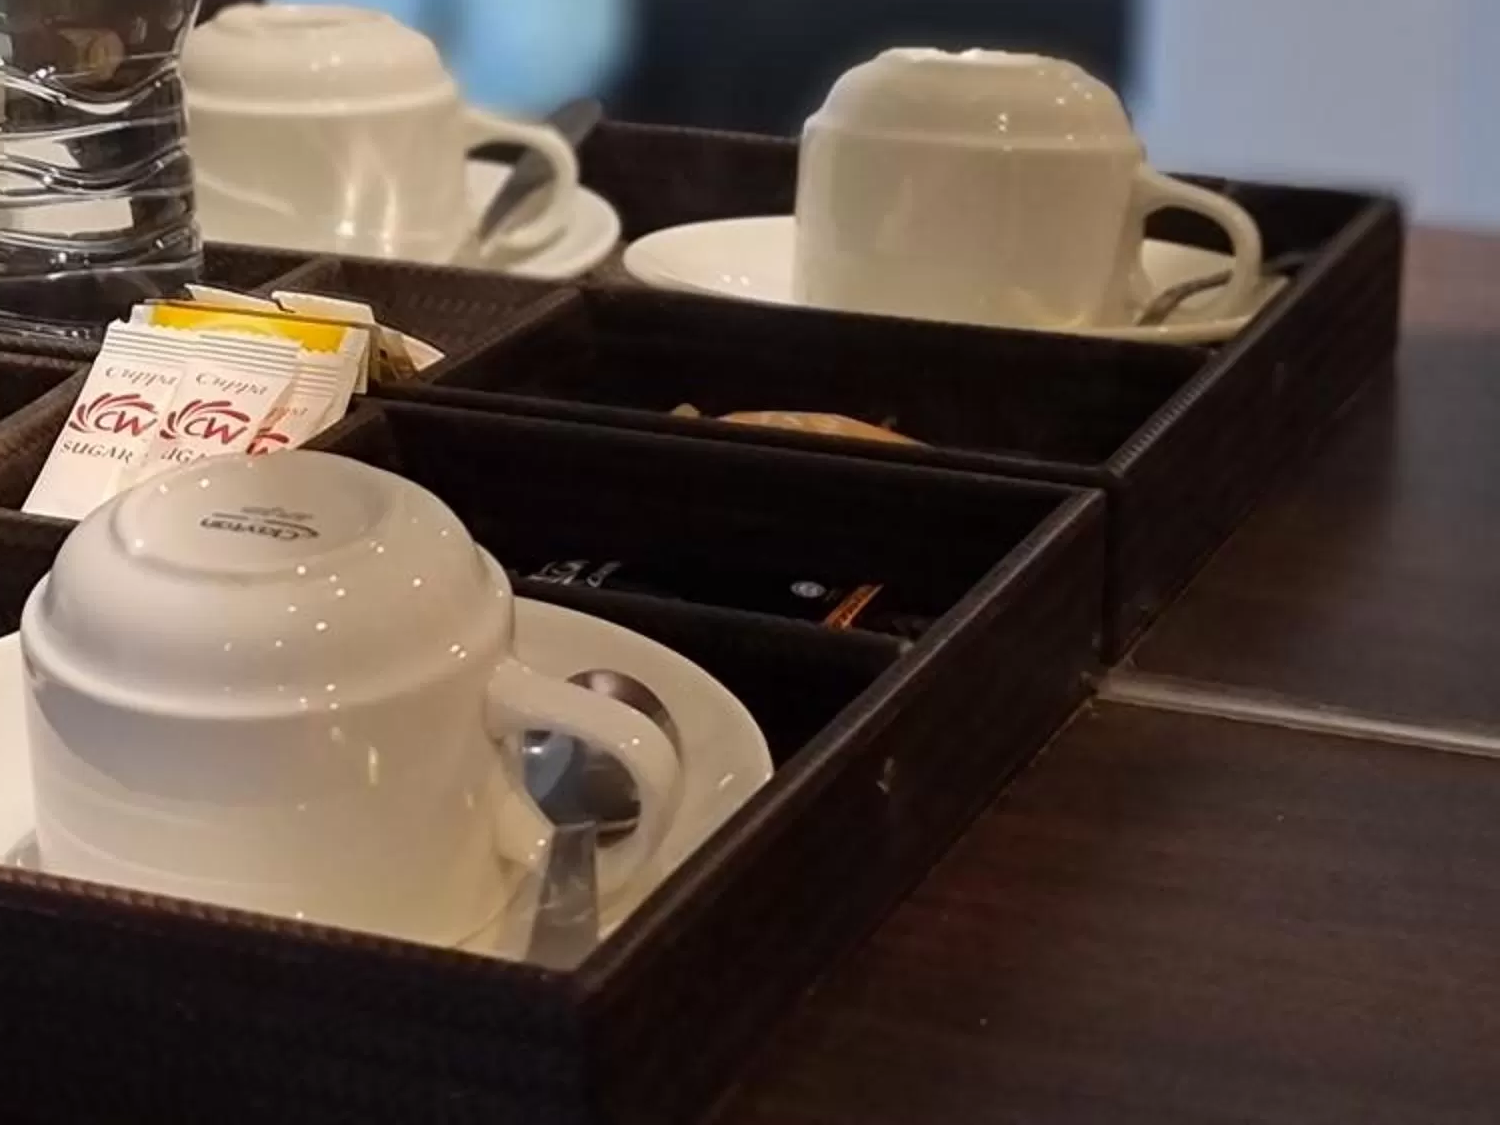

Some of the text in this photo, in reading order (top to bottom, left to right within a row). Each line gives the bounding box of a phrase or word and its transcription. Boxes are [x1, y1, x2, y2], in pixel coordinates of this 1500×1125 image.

[105, 366, 178, 387] Cuppa
[195, 374, 268, 396] Cuppa
[94, 410, 158, 437] CW
[183, 417, 249, 445] CW
[62, 441, 134, 464] SUGAR
